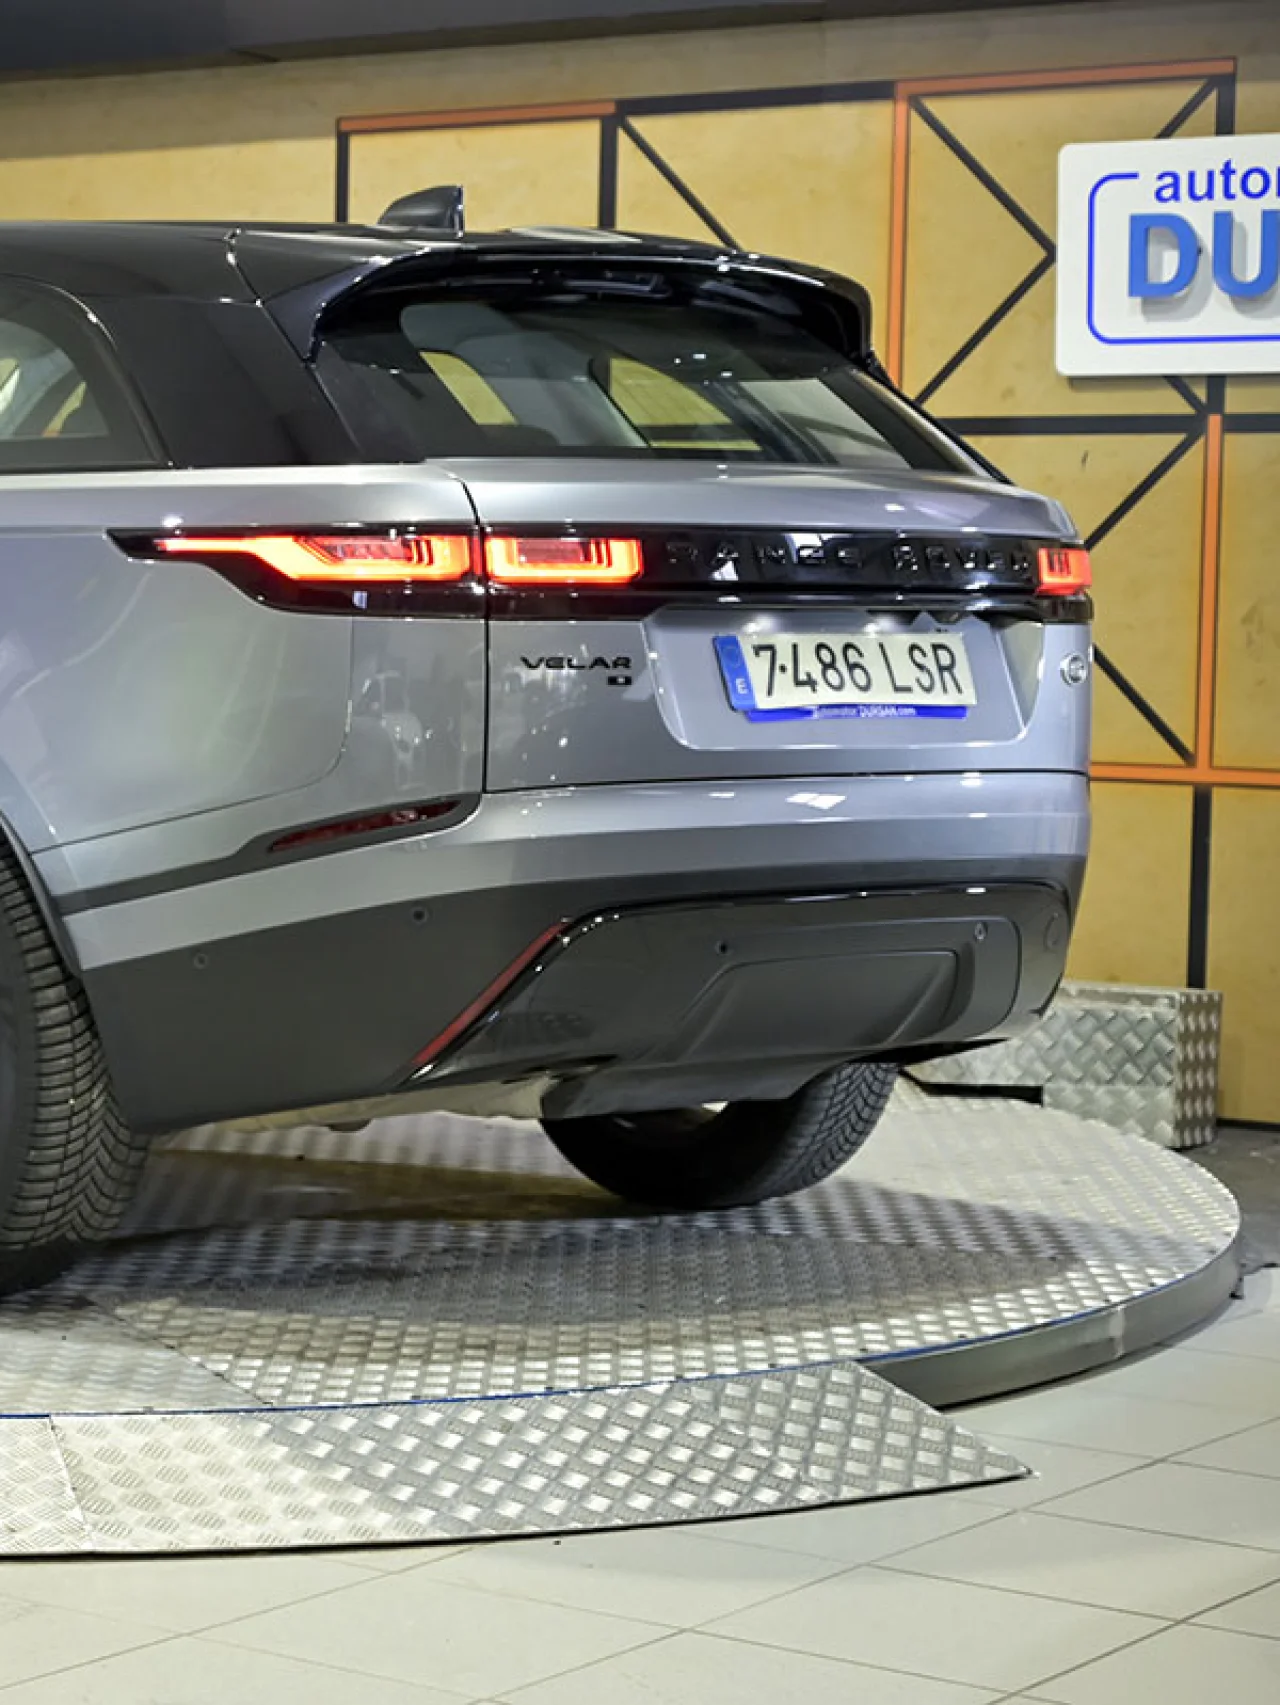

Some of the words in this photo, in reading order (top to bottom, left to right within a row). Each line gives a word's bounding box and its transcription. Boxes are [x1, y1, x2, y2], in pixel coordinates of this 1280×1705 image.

[1154, 158, 1280, 203] auto
[519, 656, 633, 670] VELAR
[878, 643, 963, 694] LSR
[735, 677, 749, 695] E
